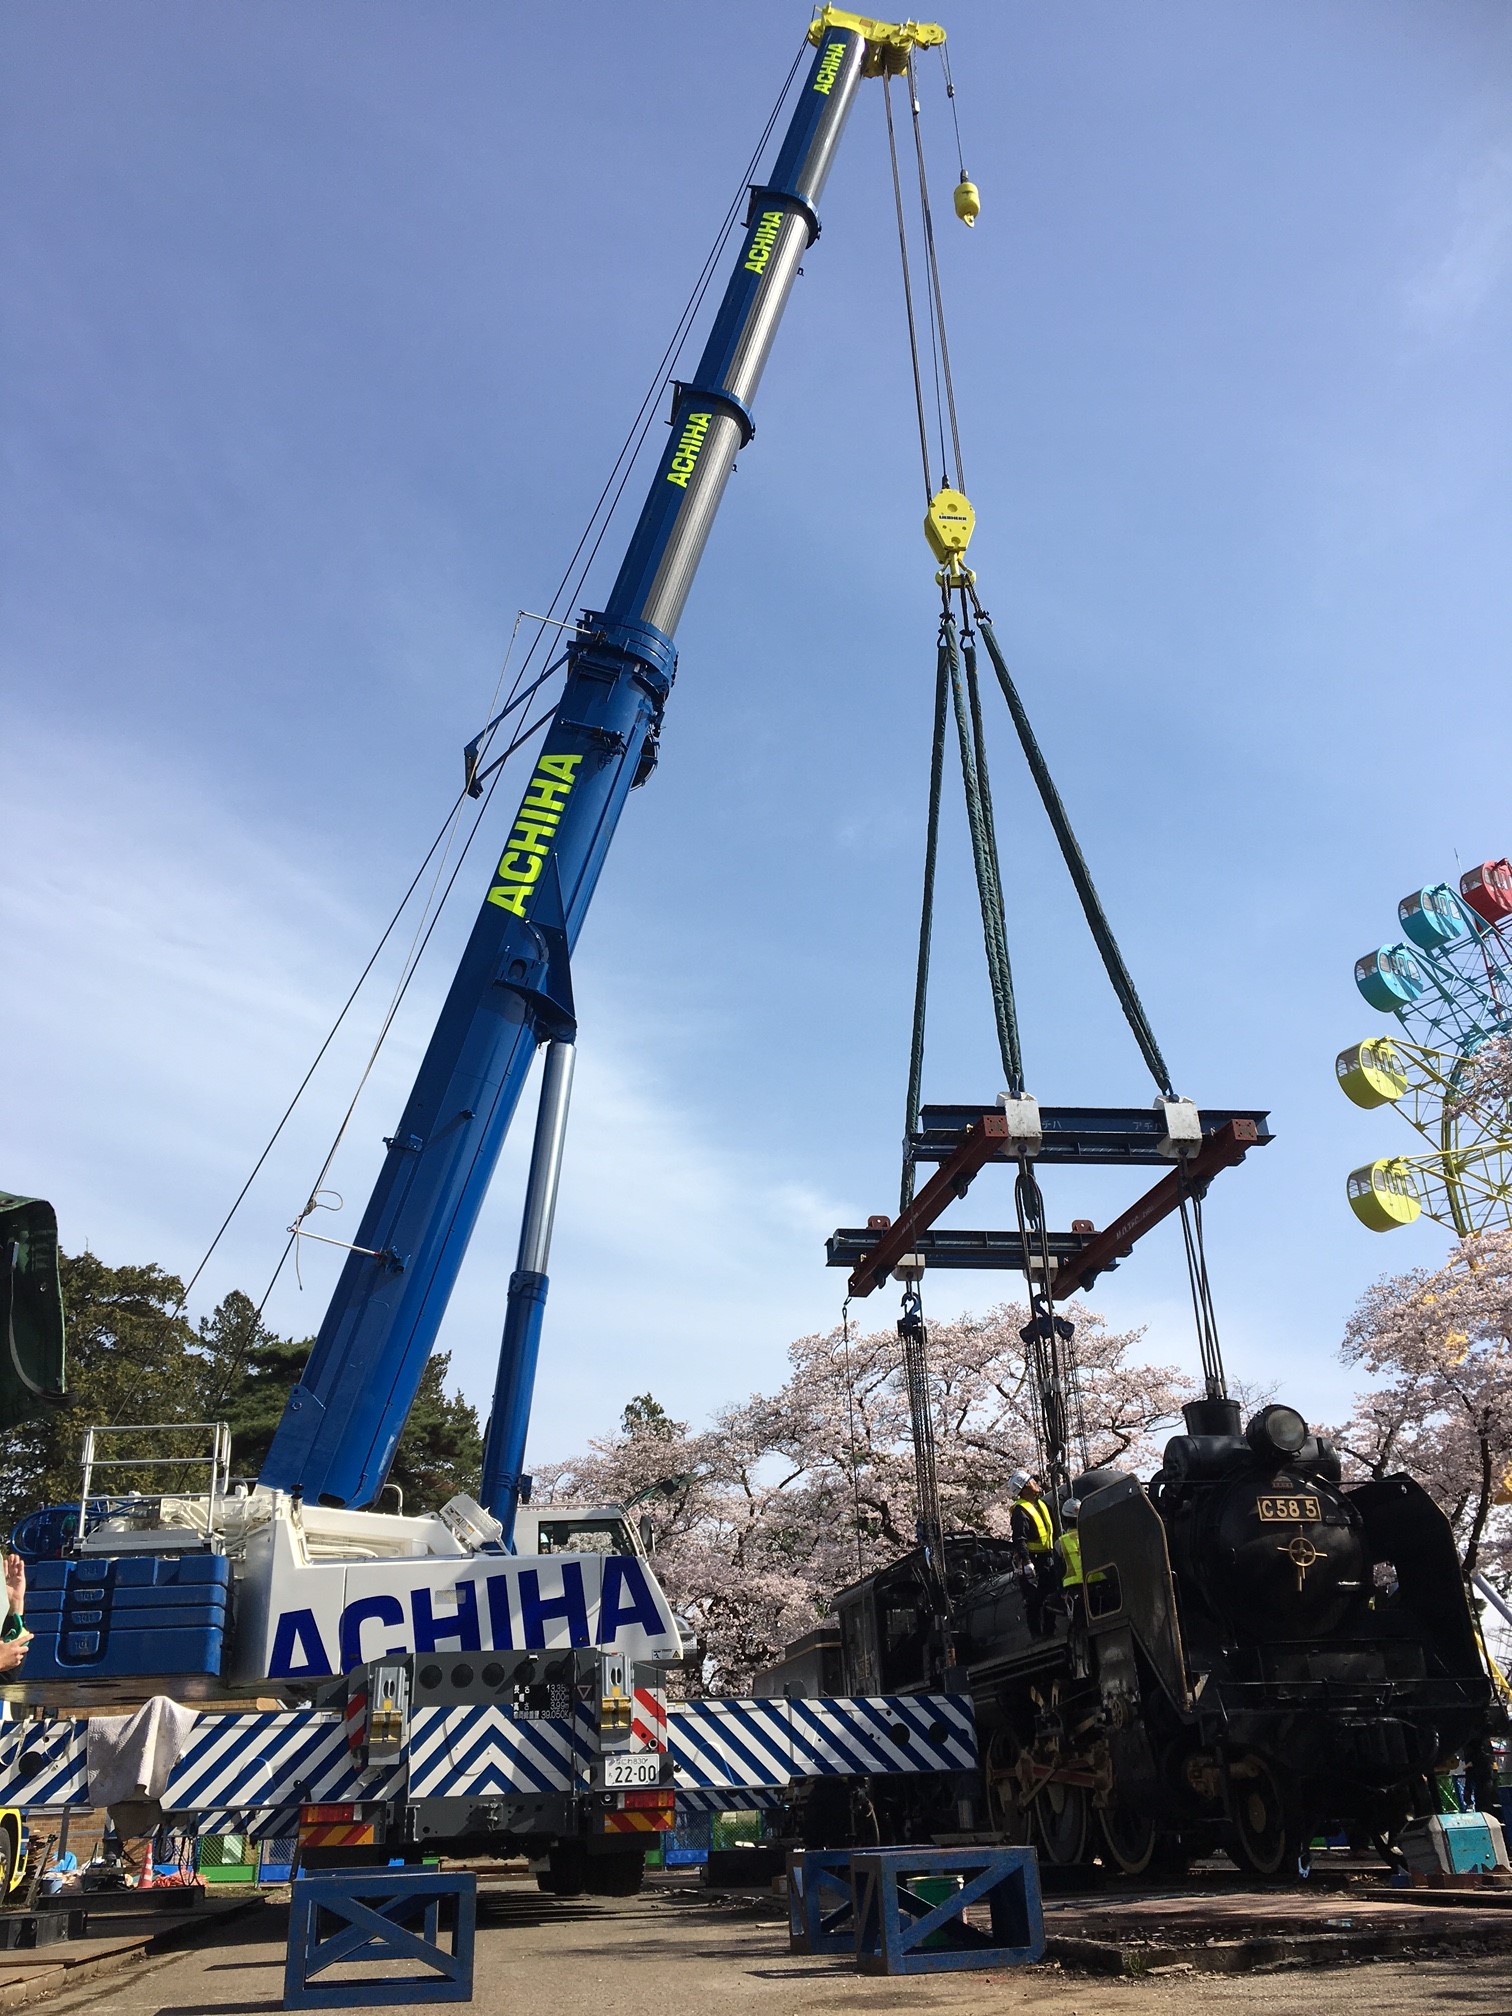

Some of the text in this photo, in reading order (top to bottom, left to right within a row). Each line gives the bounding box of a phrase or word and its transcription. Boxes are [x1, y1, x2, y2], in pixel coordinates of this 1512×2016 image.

[812, 43, 846, 95] ACHIHA
[744, 211, 783, 275] ACHIHA
[667, 412, 712, 488] ACHIHA
[487, 754, 583, 918] ACHIHA
[1261, 1500, 1317, 1518] C58 5
[268, 1556, 667, 1678] ACHIHA
[615, 1765, 656, 1783] 22-00
